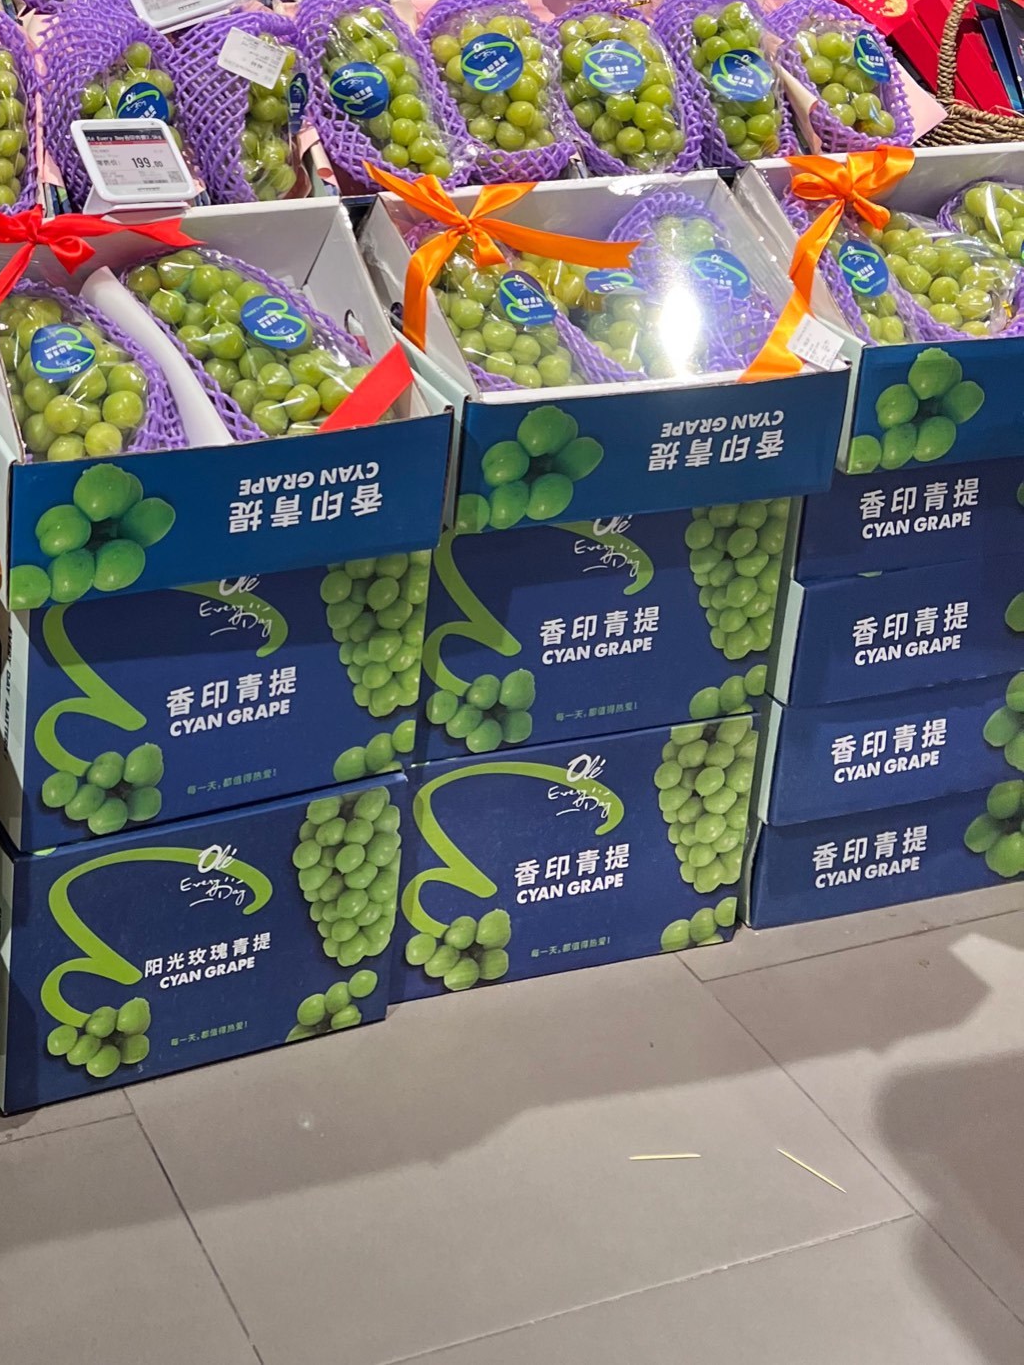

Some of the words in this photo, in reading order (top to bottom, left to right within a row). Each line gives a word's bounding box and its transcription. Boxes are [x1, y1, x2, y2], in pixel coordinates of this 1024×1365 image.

[132, 156, 164, 169] 199.00
[660, 415, 727, 438] GRAPE
[732, 409, 785, 432] CYAN
[648, 429, 785, 472] 香印青提
[238, 471, 314, 496] GRAPE
[320, 461, 380, 486] CYAN
[228, 482, 383, 534] 香印青提
[859, 477, 980, 521] 香印青提
[862, 519, 910, 540] CYAN
[913, 511, 971, 533] GRAPE
[574, 539, 616, 564] Every
[610, 549, 640, 577] Day
[199, 602, 247, 626] Every
[240, 611, 274, 637] Day
[540, 605, 660, 646] 香印青提
[852, 601, 969, 647] 香印青提
[541, 642, 592, 665] CYAN
[596, 636, 653, 659] GRAPE
[854, 644, 901, 667] CYAN
[905, 634, 961, 657] GRAPE
[166, 665, 297, 717] 香印青提
[169, 713, 222, 737] CYAN
[226, 700, 291, 726] GRAPE
[830, 718, 947, 766] 香印青提
[565, 754, 606, 783] Olé
[833, 761, 881, 784] CYAN
[883, 750, 940, 775] GRAPE
[547, 785, 589, 807] Every
[583, 796, 611, 819] Day
[197, 844, 238, 874] Olé
[812, 825, 928, 872] 香印青提
[514, 842, 630, 888] 香印青提
[814, 867, 862, 890] CYAN
[865, 856, 921, 880] GRAPE
[179, 876, 223, 900] Every
[216, 884, 246, 906] Day
[516, 882, 562, 905] CYAN
[566, 872, 624, 897] GRAPE
[144, 932, 271, 978] 阳光玫瑰青提
[159, 966, 201, 990] CYAN
[205, 955, 256, 980] GRAPE
